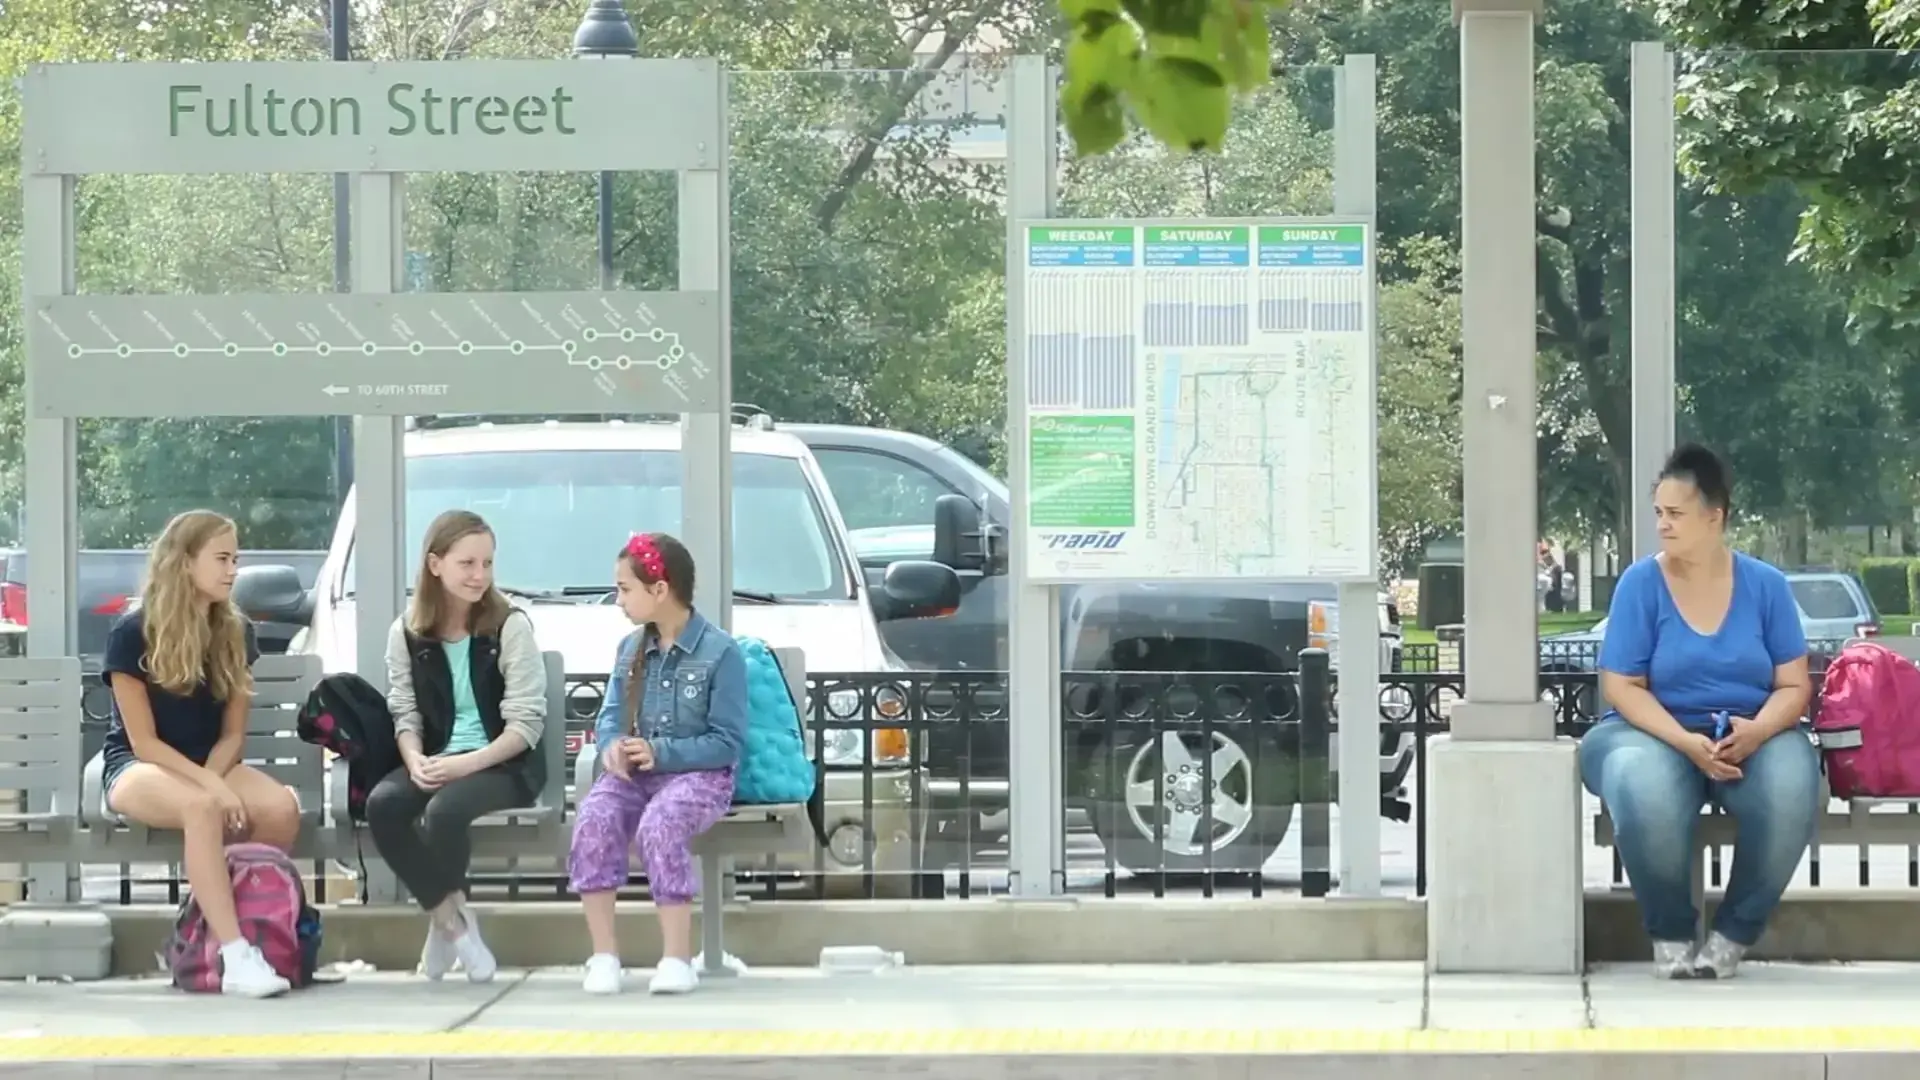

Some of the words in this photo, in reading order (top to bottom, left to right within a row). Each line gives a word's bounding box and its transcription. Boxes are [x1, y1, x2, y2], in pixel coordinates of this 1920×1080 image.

[168, 83, 361, 137] Fulton
[387, 83, 577, 137] Street
[1048, 230, 1115, 242] WEEKDAY
[1160, 230, 1233, 242] SATURDAY
[1282, 230, 1338, 242] SUNDAY
[357, 384, 373, 396] TO
[375, 384, 404, 396] 60TH
[407, 384, 449, 396] STREET
[1145, 352, 1157, 402] RAPIDS
[1145, 406, 1157, 455] GRAND
[1145, 459, 1157, 540] DOWNTOWN
